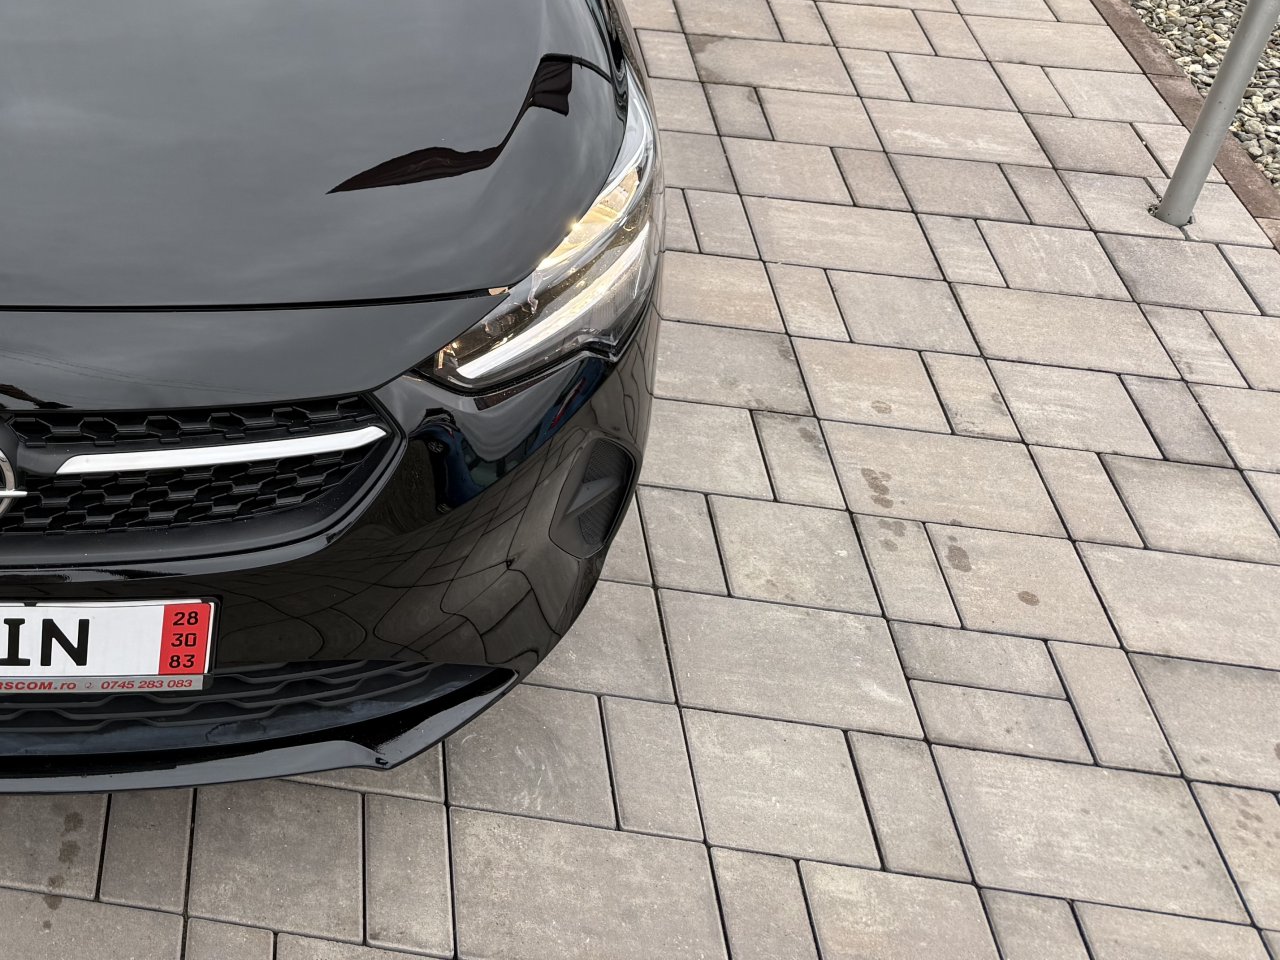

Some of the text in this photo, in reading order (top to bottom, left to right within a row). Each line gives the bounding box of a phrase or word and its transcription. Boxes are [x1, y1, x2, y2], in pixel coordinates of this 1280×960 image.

[172, 611, 199, 626] 28
[170, 632, 198, 648] 30
[168, 654, 196, 669] 83
[100, 680, 135, 690] 0745
[138, 679, 164, 689] 283
[166, 678, 193, 688] 083
